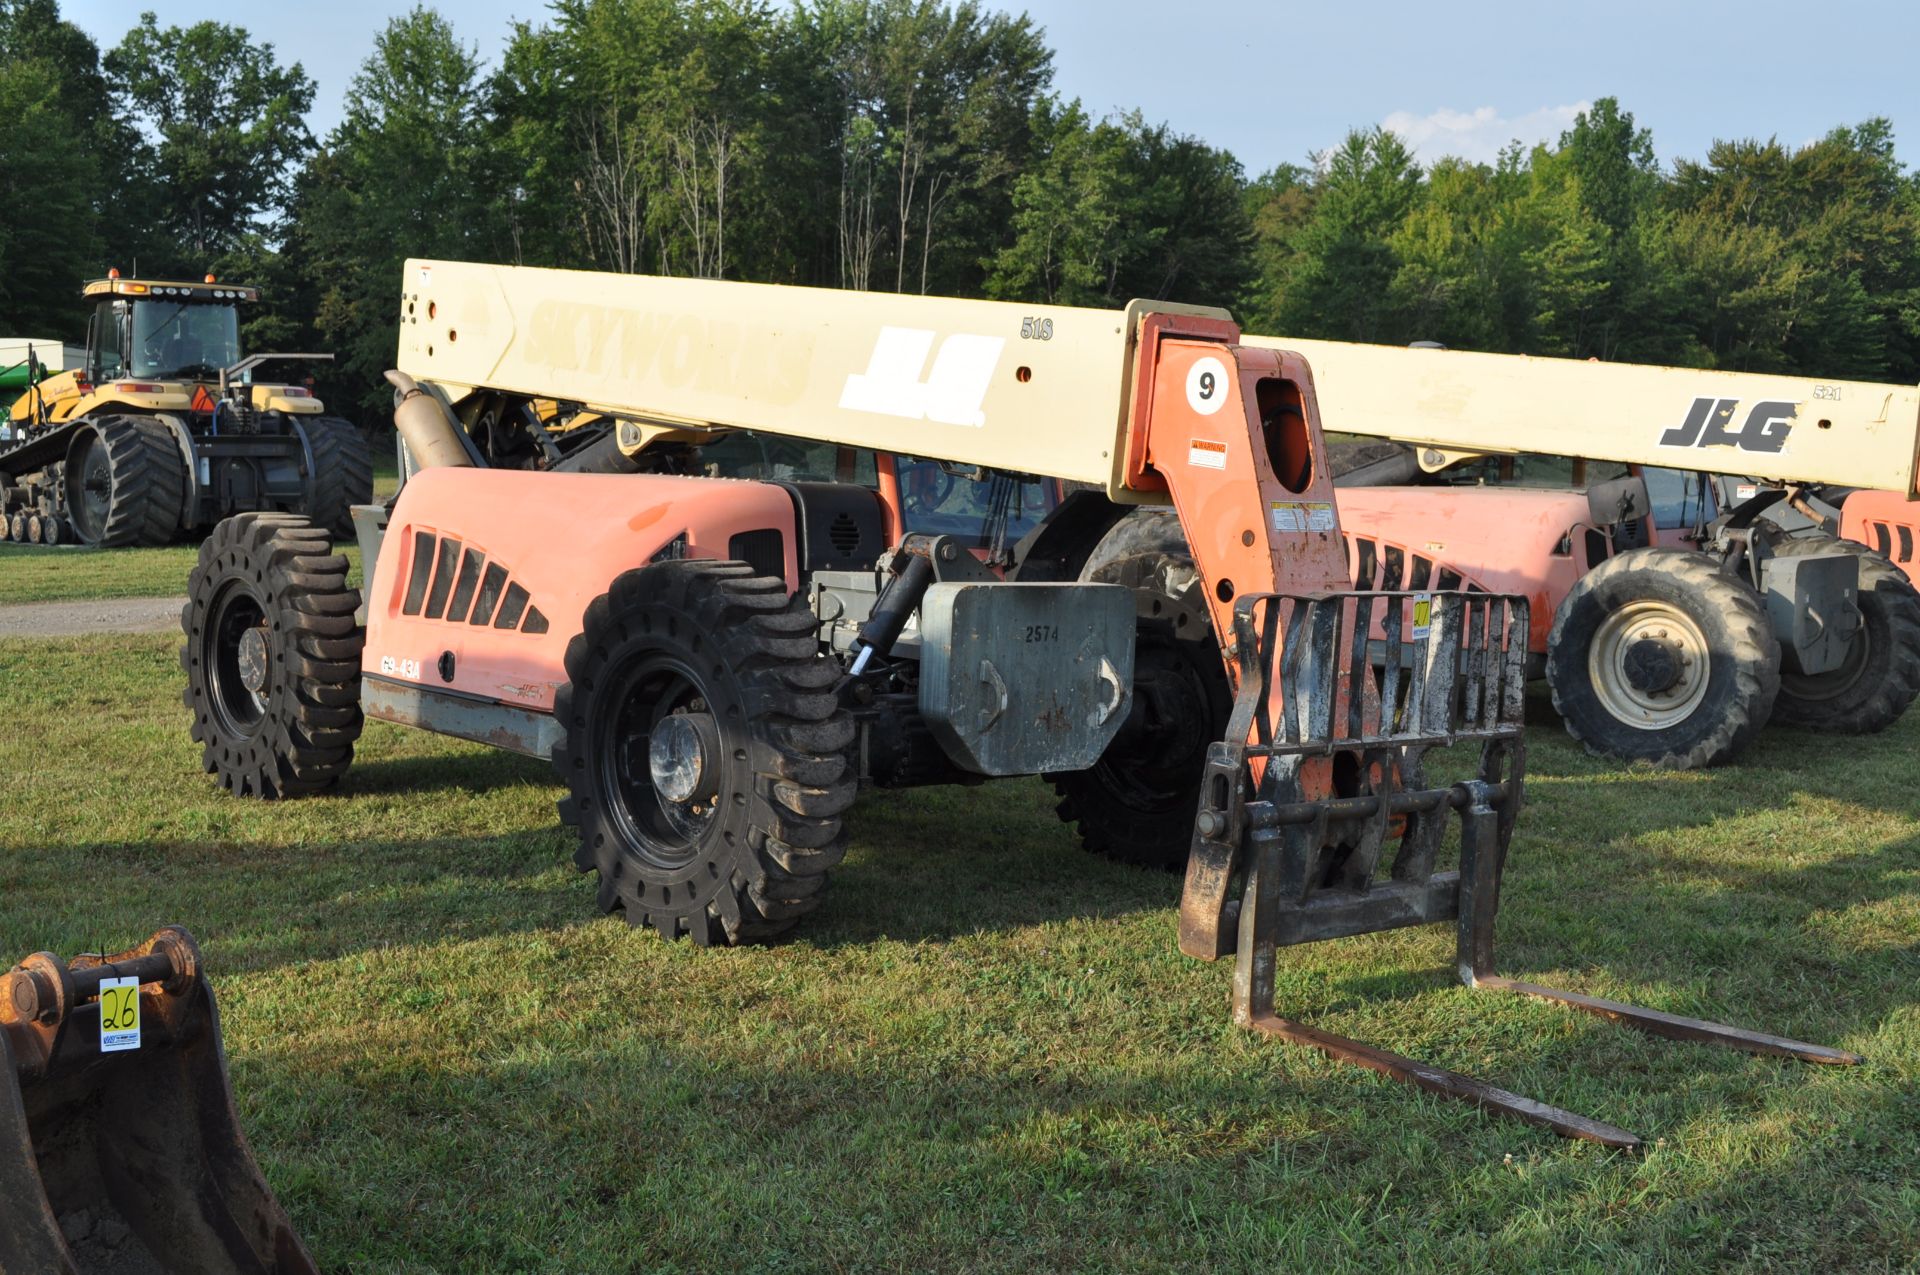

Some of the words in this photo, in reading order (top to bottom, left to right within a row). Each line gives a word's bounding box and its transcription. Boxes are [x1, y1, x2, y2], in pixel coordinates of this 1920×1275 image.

[1020, 316, 1054, 341] 518
[1199, 371, 1216, 400] 9
[1812, 384, 1842, 401] 521
[1658, 397, 1804, 454] JLG
[1413, 601, 1430, 627] 27
[1025, 625, 1058, 643] 2574
[380, 655, 420, 680] G9-43A
[102, 987, 135, 1029] 26
